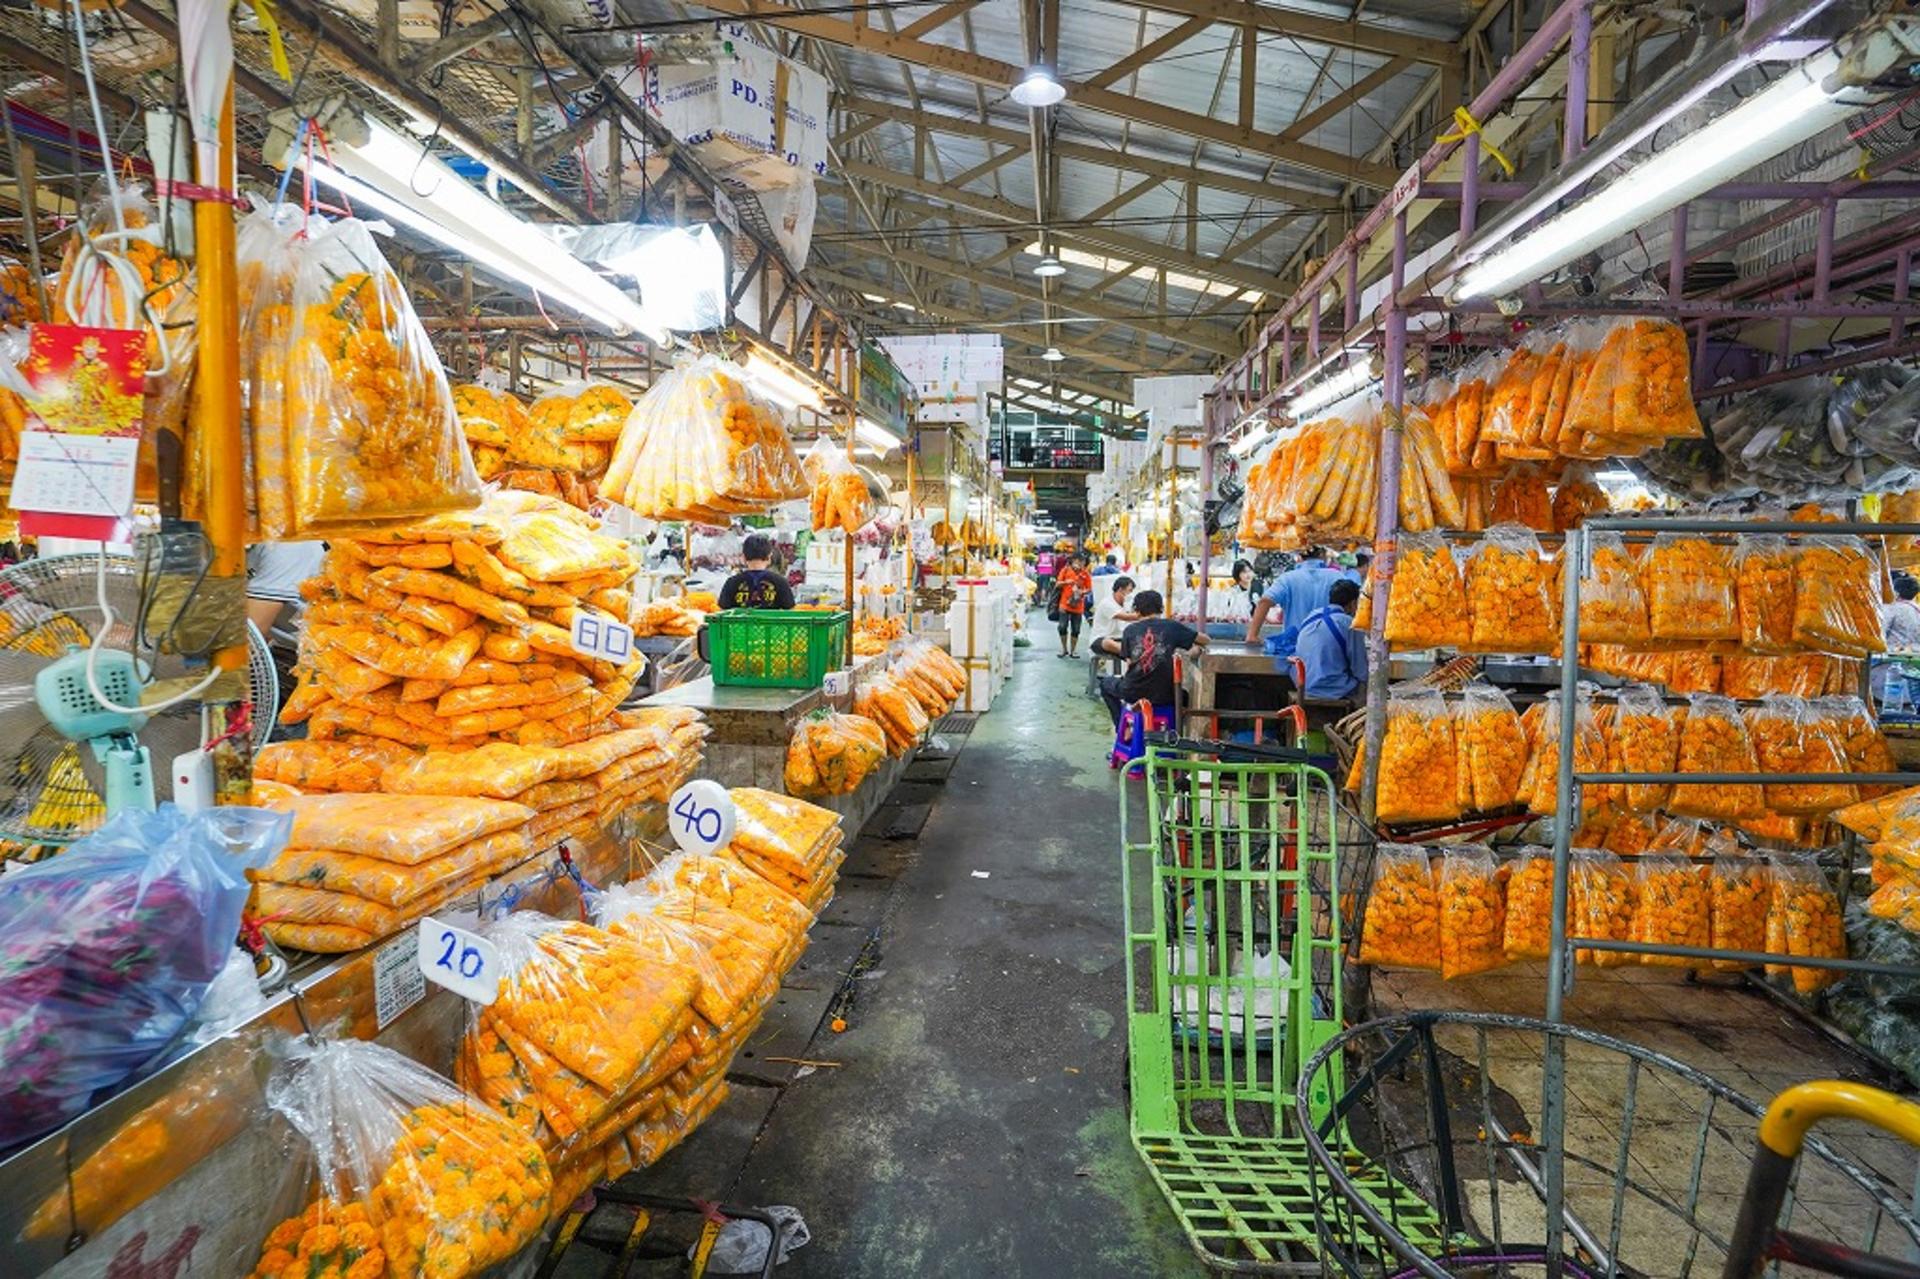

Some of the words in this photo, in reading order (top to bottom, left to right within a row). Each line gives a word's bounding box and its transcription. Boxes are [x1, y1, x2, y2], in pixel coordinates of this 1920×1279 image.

[731, 78, 763, 108] PD.
[674, 792, 722, 843] 40
[436, 931, 484, 979] 20
